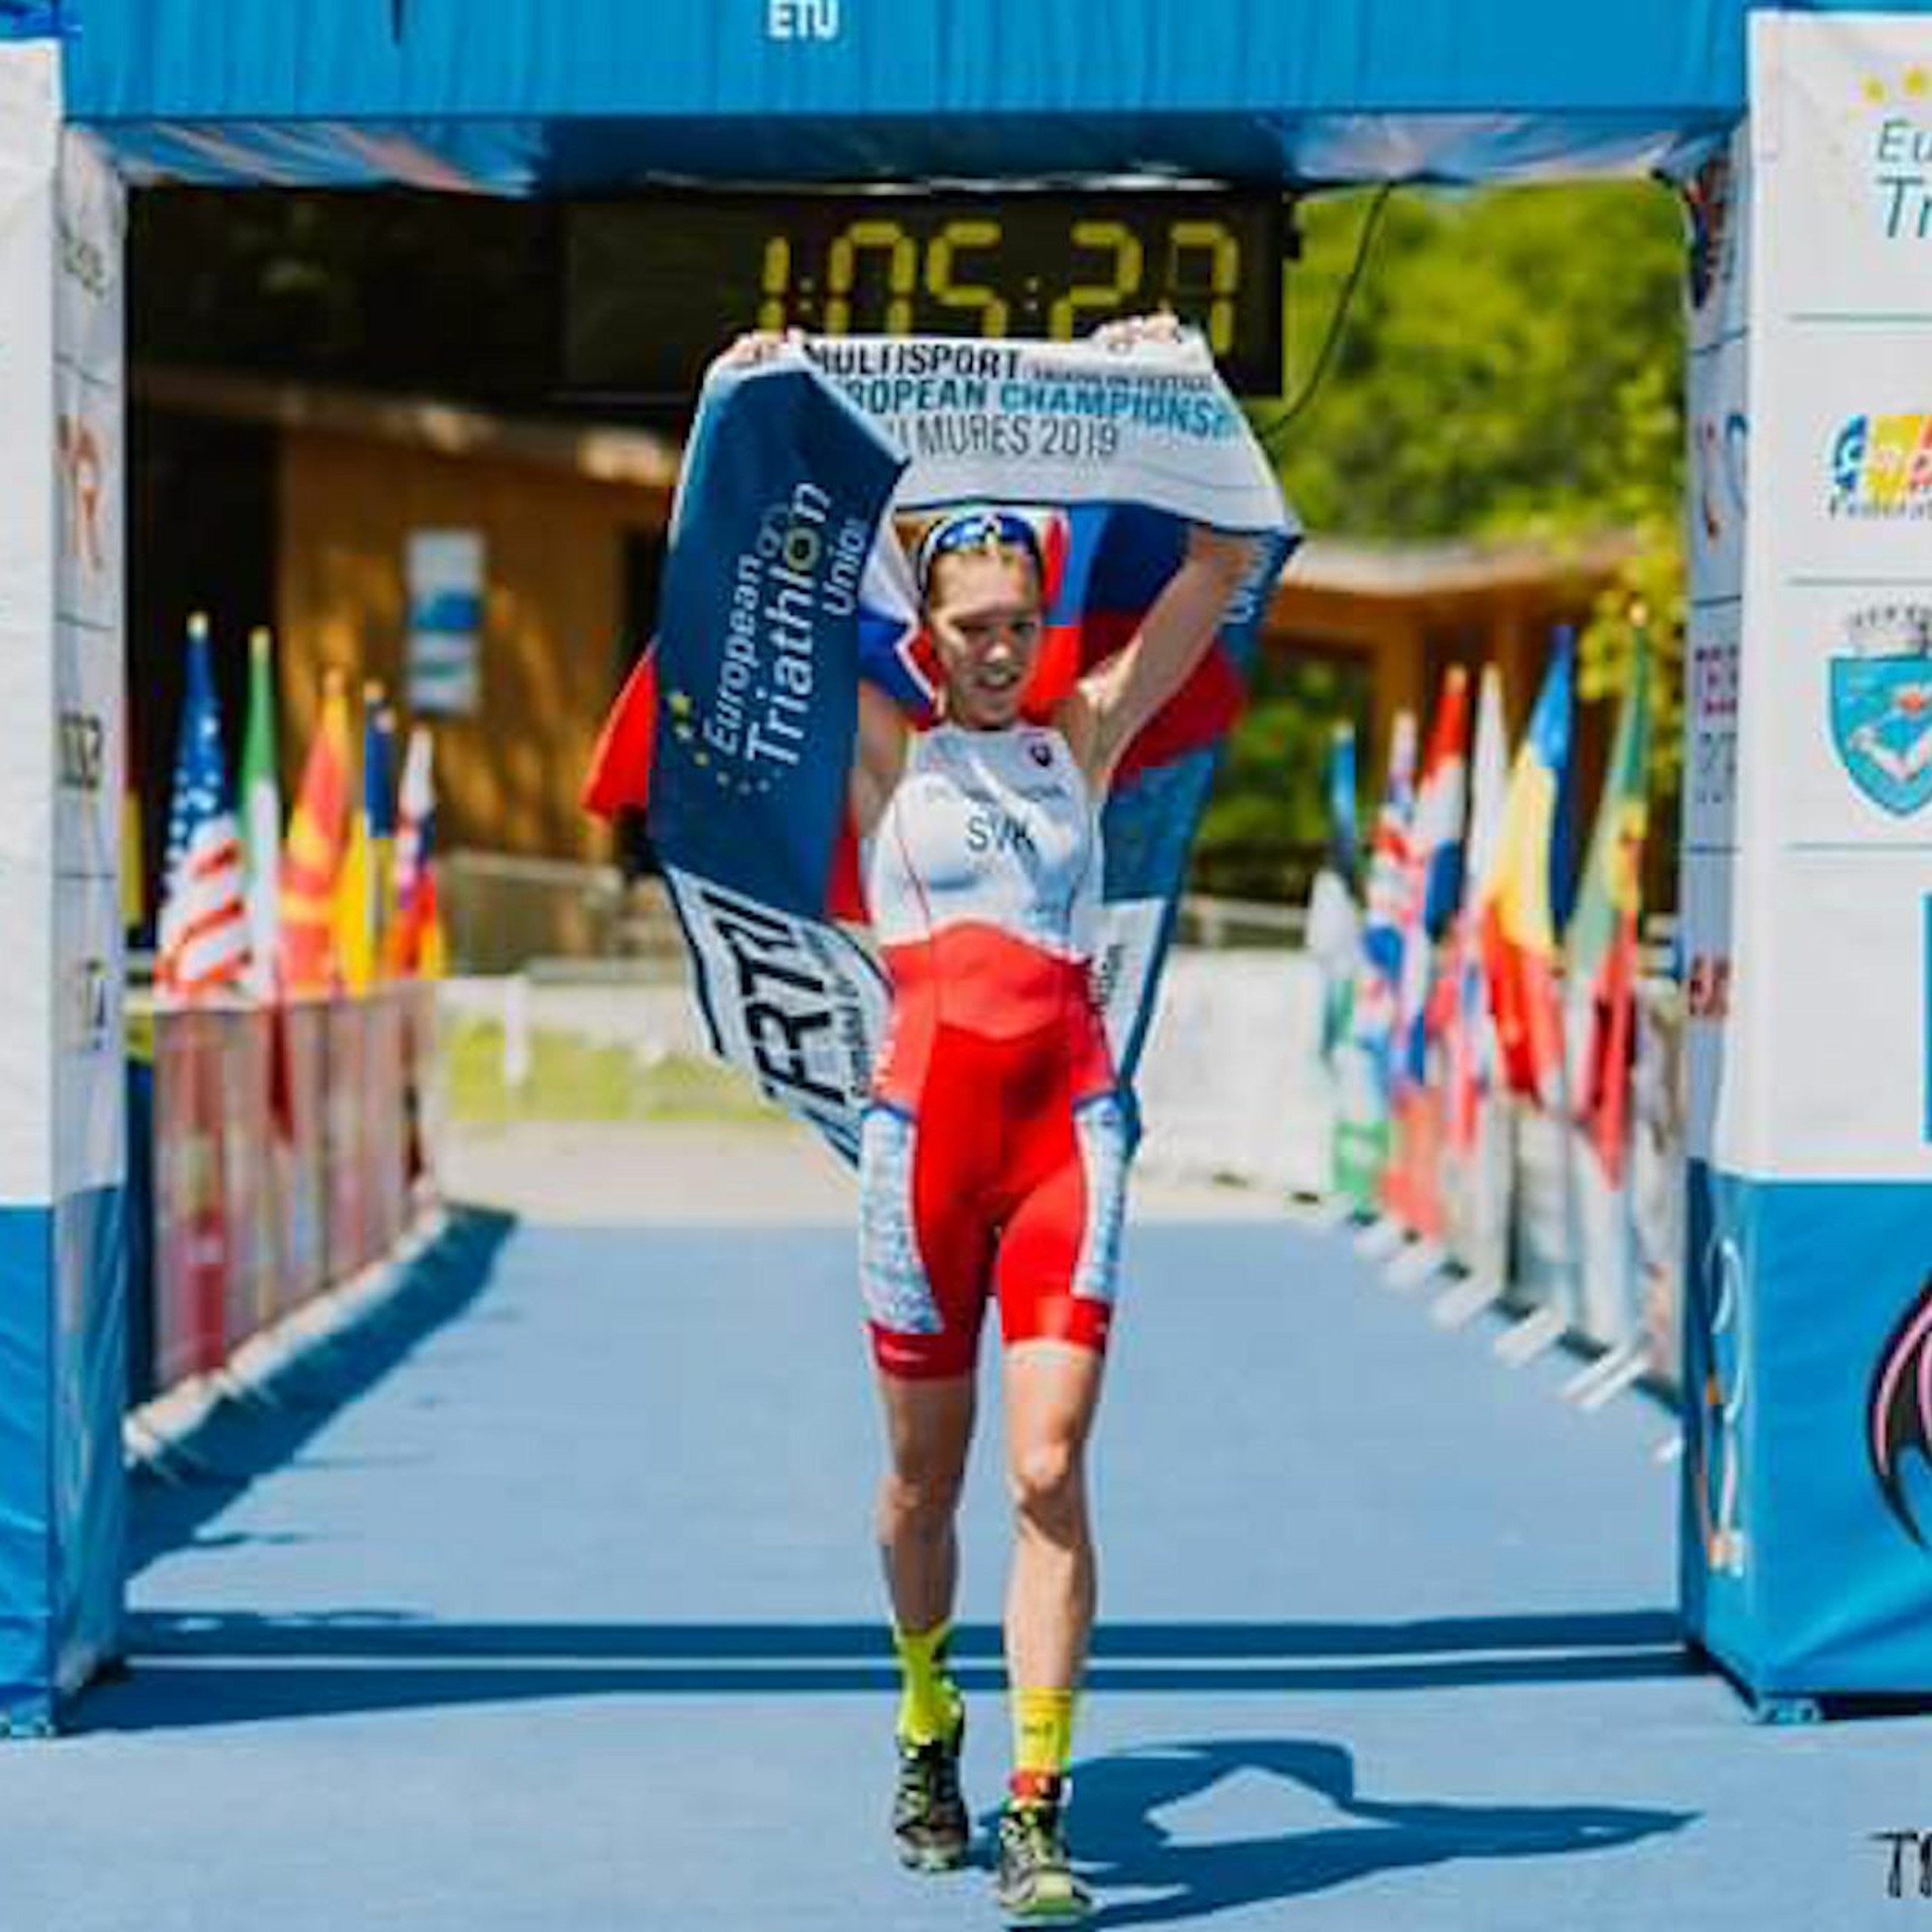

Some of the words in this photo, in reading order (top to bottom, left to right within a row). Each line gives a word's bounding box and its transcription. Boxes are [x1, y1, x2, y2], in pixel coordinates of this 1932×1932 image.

[768, 0, 840, 41] ETU
[1879, 116, 1932, 162] Eu
[1877, 173, 1932, 238] Tr
[757, 220, 1238, 355] 1:05:27
[836, 378, 987, 414] ROPEAN
[916, 415, 1031, 455] MURES
[1039, 417, 1117, 455] 2019
[745, 481, 832, 767] Triathlon
[707, 554, 765, 757] European
